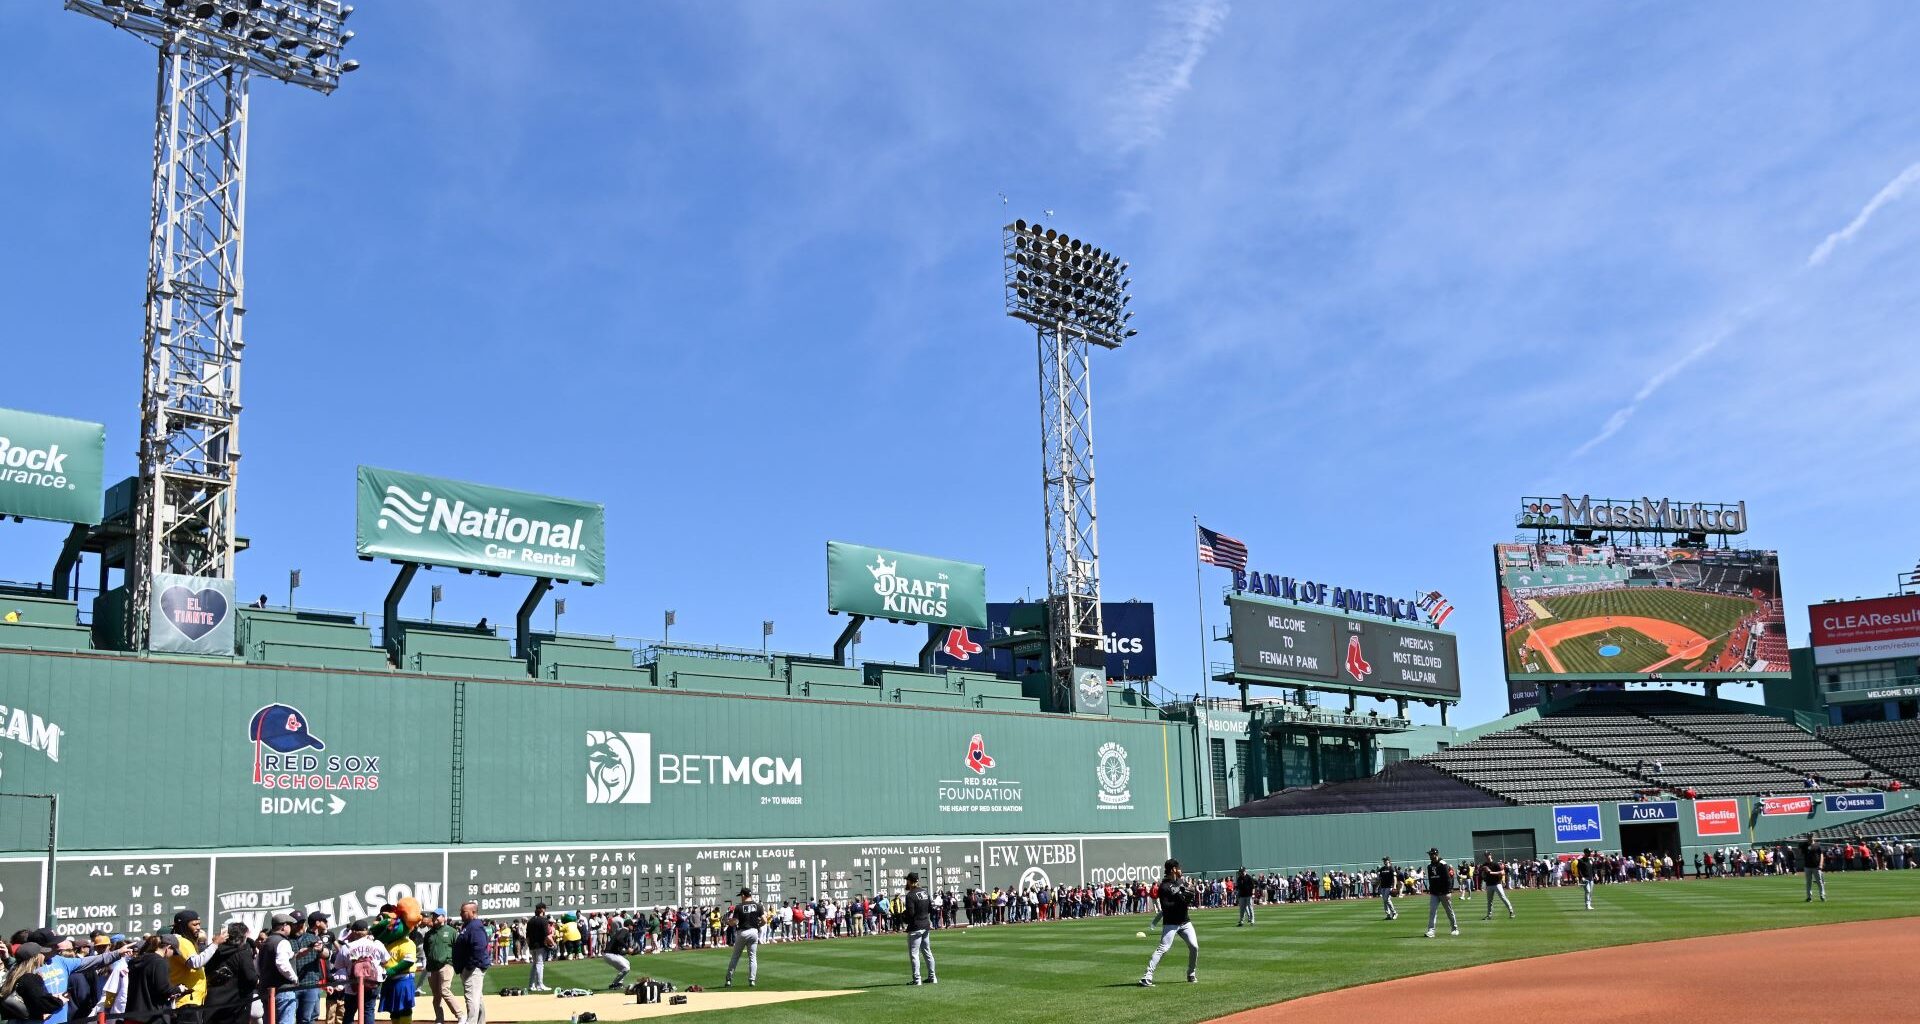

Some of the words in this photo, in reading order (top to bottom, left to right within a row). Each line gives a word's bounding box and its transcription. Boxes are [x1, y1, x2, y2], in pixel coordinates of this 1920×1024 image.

[1561, 494, 1747, 532] MassMutual
[428, 498, 584, 551] National
[484, 543, 515, 560] Car
[521, 548, 576, 567] Rental
[874, 574, 950, 599] DRAFT
[1233, 569, 1297, 600] BANK
[1301, 581, 1328, 604] OF
[1332, 586, 1418, 621] AMERICA
[187, 598, 201, 610] EL
[883, 592, 947, 618] KINGS
[174, 610, 214, 625] TIANTE
[1267, 615, 1306, 633] WELCOME
[1823, 609, 1920, 630] CLEAResult
[1282, 635, 1294, 648] TO
[1399, 636, 1434, 651] AMERICA'S
[1259, 651, 1294, 667] FENWAY
[1296, 656, 1318, 670] PARK
[1393, 652, 1411, 665] MOST
[1413, 654, 1442, 669] BELOVED
[1402, 668, 1437, 684] BALLPARK
[1867, 689, 1901, 698] WELCOME
[264, 753, 318, 771] RED
[327, 755, 380, 773] SOX
[659, 754, 802, 785] BETMGM
[263, 773, 379, 790] SCHOLARS
[939, 787, 1022, 800] FOUNDATION
[261, 797, 324, 814] BIDMC
[781, 797, 802, 805] WAGER
[1781, 800, 1811, 812] TICKET
[1556, 815, 1572, 824] city
[1698, 810, 1736, 820] Safelite
[1557, 823, 1587, 832] cruises
[696, 850, 751, 860] AMERICAN
[756, 849, 795, 858] LEAGUE
[861, 847, 904, 855] NATIONAL
[908, 846, 941, 854] LEAGUE
[989, 846, 1019, 867] F.W.
[1024, 844, 1077, 865] WEBB
[498, 853, 576, 865] FENWAY
[590, 852, 637, 862] PARK
[821, 859, 827, 868] P
[853, 858, 861, 867] IN
[864, 858, 870, 867] R
[881, 858, 886, 866] P
[911, 857, 918, 865] IN
[921, 857, 926, 865] R
[936, 856, 941, 864] P
[973, 855, 979, 863] R
[89, 865, 113, 876] AL
[124, 863, 173, 875] EAST
[470, 869, 478, 880] P
[526, 867, 530, 877] 1
[535, 867, 542, 877] 2
[545, 867, 552, 877] 3
[558, 866, 566, 876] 4
[568, 866, 576, 876] 5
[578, 866, 585, 876] 6
[591, 866, 598, 875] 7
[601, 866, 608, 875] 8
[610, 866, 617, 875] 9
[622, 865, 632, 875] 10
[641, 864, 648, 874] R
[655, 864, 662, 873] H
[668, 863, 674, 873] E
[685, 863, 692, 872] P
[723, 862, 732, 871] IN
[735, 861, 741, 871] R
[752, 861, 758, 870] P
[788, 860, 796, 869] IN
[800, 860, 806, 868] R
[700, 876, 716, 885] SEA
[765, 873, 780, 882] LAD
[836, 871, 845, 879] SF
[946, 867, 961, 875] WSH
[1091, 863, 1162, 883] moderna
[132, 886, 142, 897] W
[154, 885, 162, 897] L
[171, 885, 190, 896] GB
[468, 884, 478, 895] 59
[483, 882, 520, 894] CHICAGO
[700, 886, 716, 895] TOR
[766, 883, 780, 892] TEX
[834, 881, 848, 889] LAA
[220, 893, 258, 910] WHO
[261, 891, 292, 907] BUT
[766, 894, 781, 903] ATH
[834, 891, 848, 899] CLE
[481, 897, 520, 910] BOSTON
[83, 904, 118, 918] YORK
[129, 903, 143, 916] 13
[153, 903, 162, 915] 8
[55, 921, 113, 936] ORONTO
[129, 920, 142, 932] 12
[152, 919, 162, 931] 9
